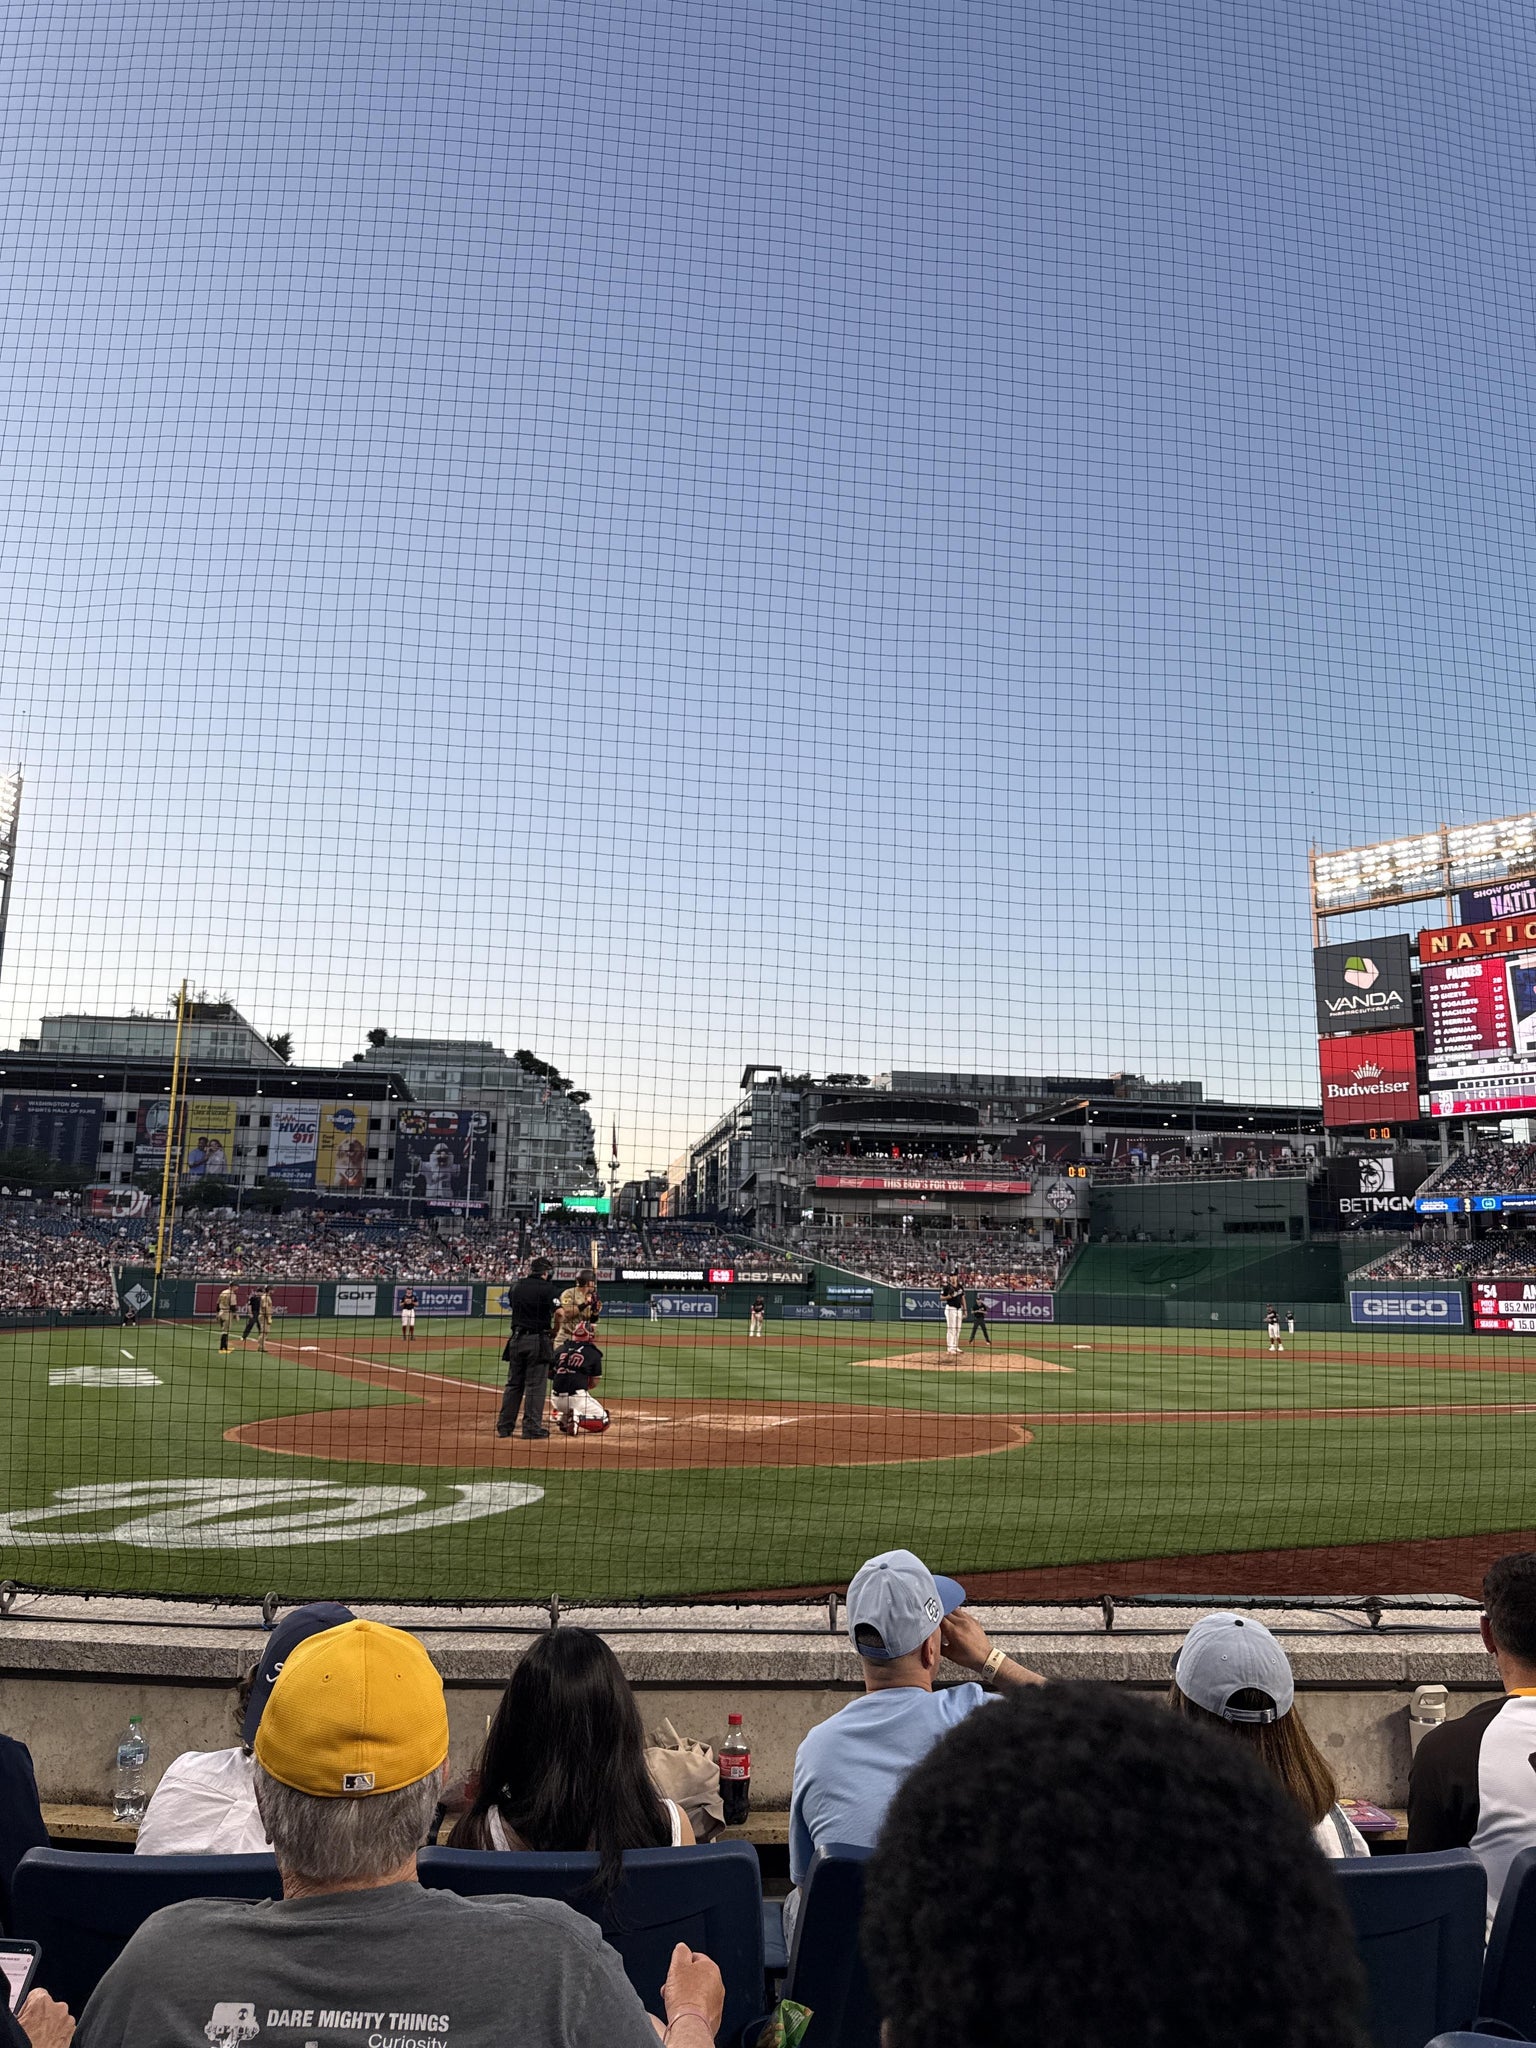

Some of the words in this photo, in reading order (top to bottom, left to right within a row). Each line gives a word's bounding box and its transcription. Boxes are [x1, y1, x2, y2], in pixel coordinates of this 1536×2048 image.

[1473, 888, 1503, 899] SHOW
[1503, 880, 1531, 892] SOME
[1446, 964, 1482, 980] PADRES
[1440, 982, 1459, 990] TATIS
[1325, 990, 1404, 1012] VANDA
[1441, 998, 1479, 1008] BOGAERTS
[1329, 1006, 1389, 1017] PHARMACEUTICALS
[1442, 1007, 1478, 1017] MACHADO
[1443, 1025, 1477, 1034] ANDUJAR
[1444, 1033, 1483, 1043] LAUREANO
[1444, 1044, 1473, 1052] FRANCE
[1327, 1080, 1410, 1098] Budweiser
[1465, 1091, 1470, 1100] 1
[1479, 1090, 1486, 1098] 0
[1495, 1088, 1500, 1097] 1
[1465, 1103, 1472, 1112] 2
[1481, 1102, 1486, 1110] 1
[1496, 1100, 1501, 1108] 1
[279, 1123, 316, 1132] HVAC
[1369, 1127, 1390, 1140] 0:10
[292, 1133, 314, 1143] 911
[1068, 1166, 1086, 1178] 0:10
[883, 1180, 902, 1189] THIS
[903, 1180, 929, 1190] BUD'S
[929, 1181, 946, 1190] FOR
[948, 1181, 967, 1191] YOU.
[1339, 1196, 1416, 1213] BETMGM
[772, 1273, 803, 1282] FAN
[337, 1291, 376, 1300] GDIT
[1478, 1284, 1498, 1298] #54
[421, 1291, 463, 1305] Inova
[673, 1300, 713, 1313] Terra
[1002, 1301, 1050, 1316] leidos
[1362, 1299, 1449, 1317] GEICO
[1504, 1303, 1521, 1312] 85.2
[1518, 1320, 1535, 1330] 15.0
[266, 2009, 314, 2028] DARE
[317, 2011, 385, 2031] MIGHTY
[388, 2012, 450, 2033] THINGS
[367, 2033, 448, 2048] Curiosity
